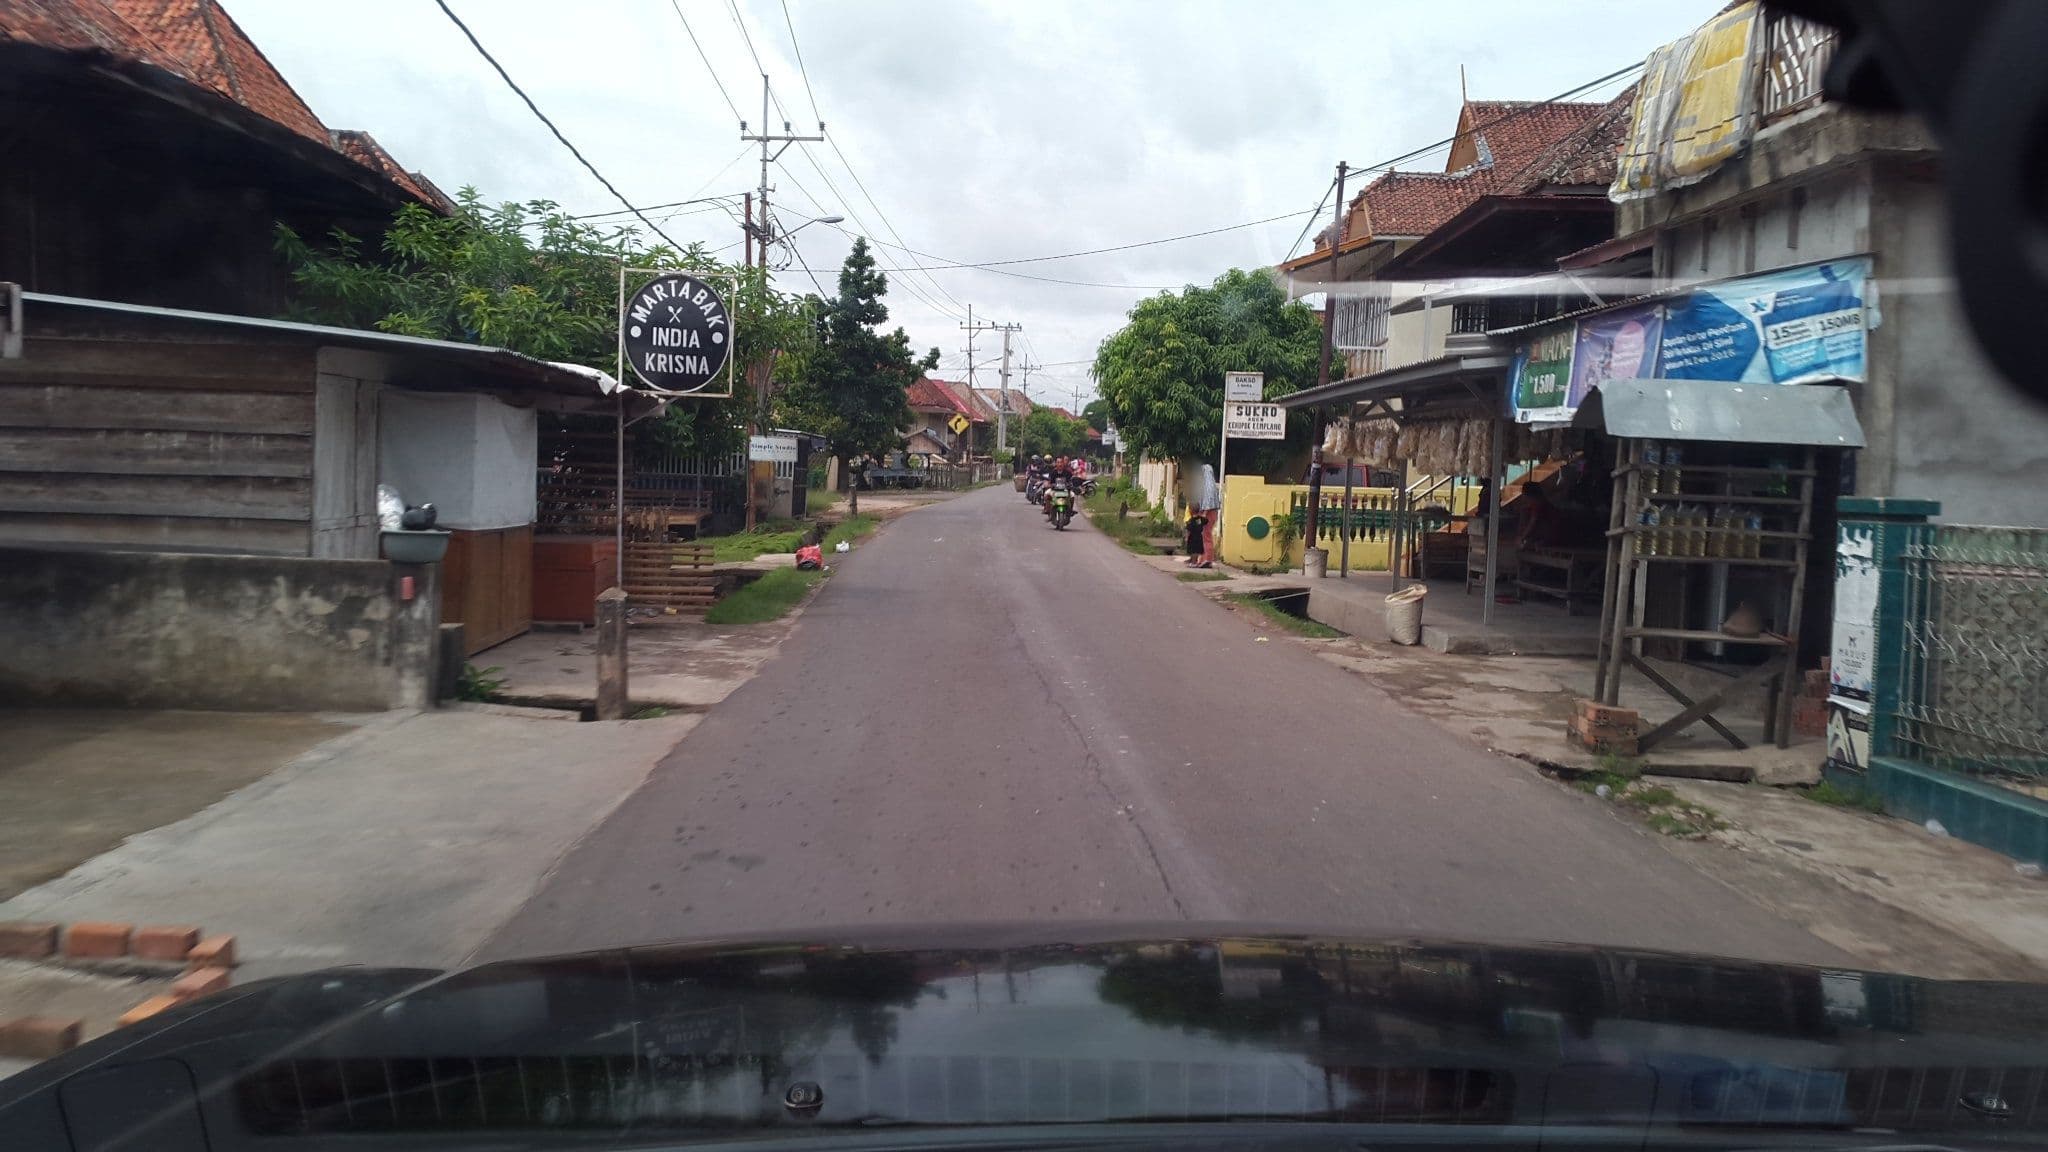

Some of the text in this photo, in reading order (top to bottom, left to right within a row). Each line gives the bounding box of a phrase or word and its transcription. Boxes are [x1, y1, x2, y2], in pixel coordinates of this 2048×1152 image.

[630, 279, 725, 329] MARTABAK
[652, 326, 701, 349] INDIA
[1770, 326, 1790, 341] 15
[1819, 313, 1861, 332] 150MB
[645, 352, 710, 375] KRISNA
[1236, 406, 1277, 417] SUKRO
